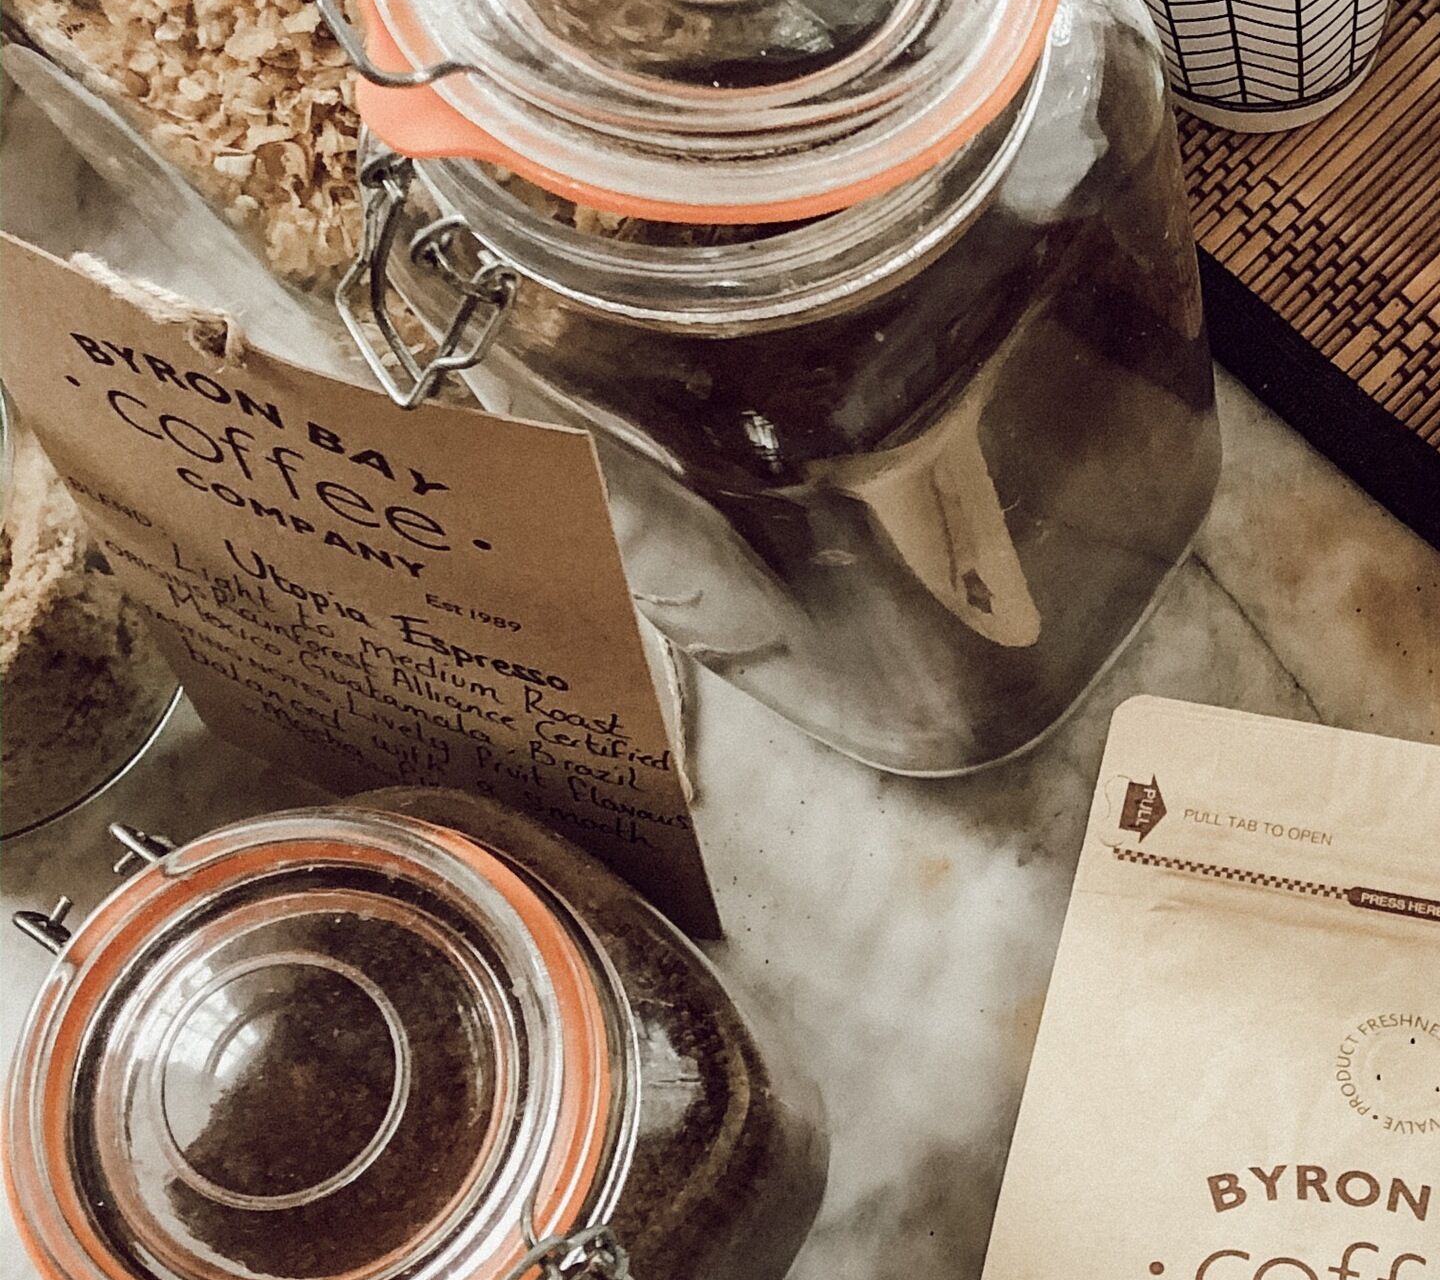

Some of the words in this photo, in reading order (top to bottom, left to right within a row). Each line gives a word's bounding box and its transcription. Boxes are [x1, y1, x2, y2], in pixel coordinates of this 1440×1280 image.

[69, 332, 285, 430] BYRON
[307, 421, 450, 497] BAY
[107, 389, 451, 553] coffee
[176, 466, 424, 579] COMPANY
[224, 539, 377, 630] Utopia
[391, 614, 569, 692] Espresso
[425, 593, 464, 616] Est
[470, 609, 522, 632] 1989
[298, 602, 336, 638] to
[523, 684, 633, 740] Roast
[393, 667, 517, 732] Alliance
[535, 720, 671, 771] Certified
[529, 738, 646, 792] Brazil
[1134, 787, 1157, 827] PULL
[1183, 808, 1223, 827] PULL
[1228, 815, 1258, 832] TAB
[1263, 822, 1284, 838] TO
[1287, 826, 1334, 847] OPEN
[1360, 892, 1406, 911] PRESS
[1336, 1034, 1372, 1117] PRODUCT
[1206, 1164, 1431, 1222] BYRON
